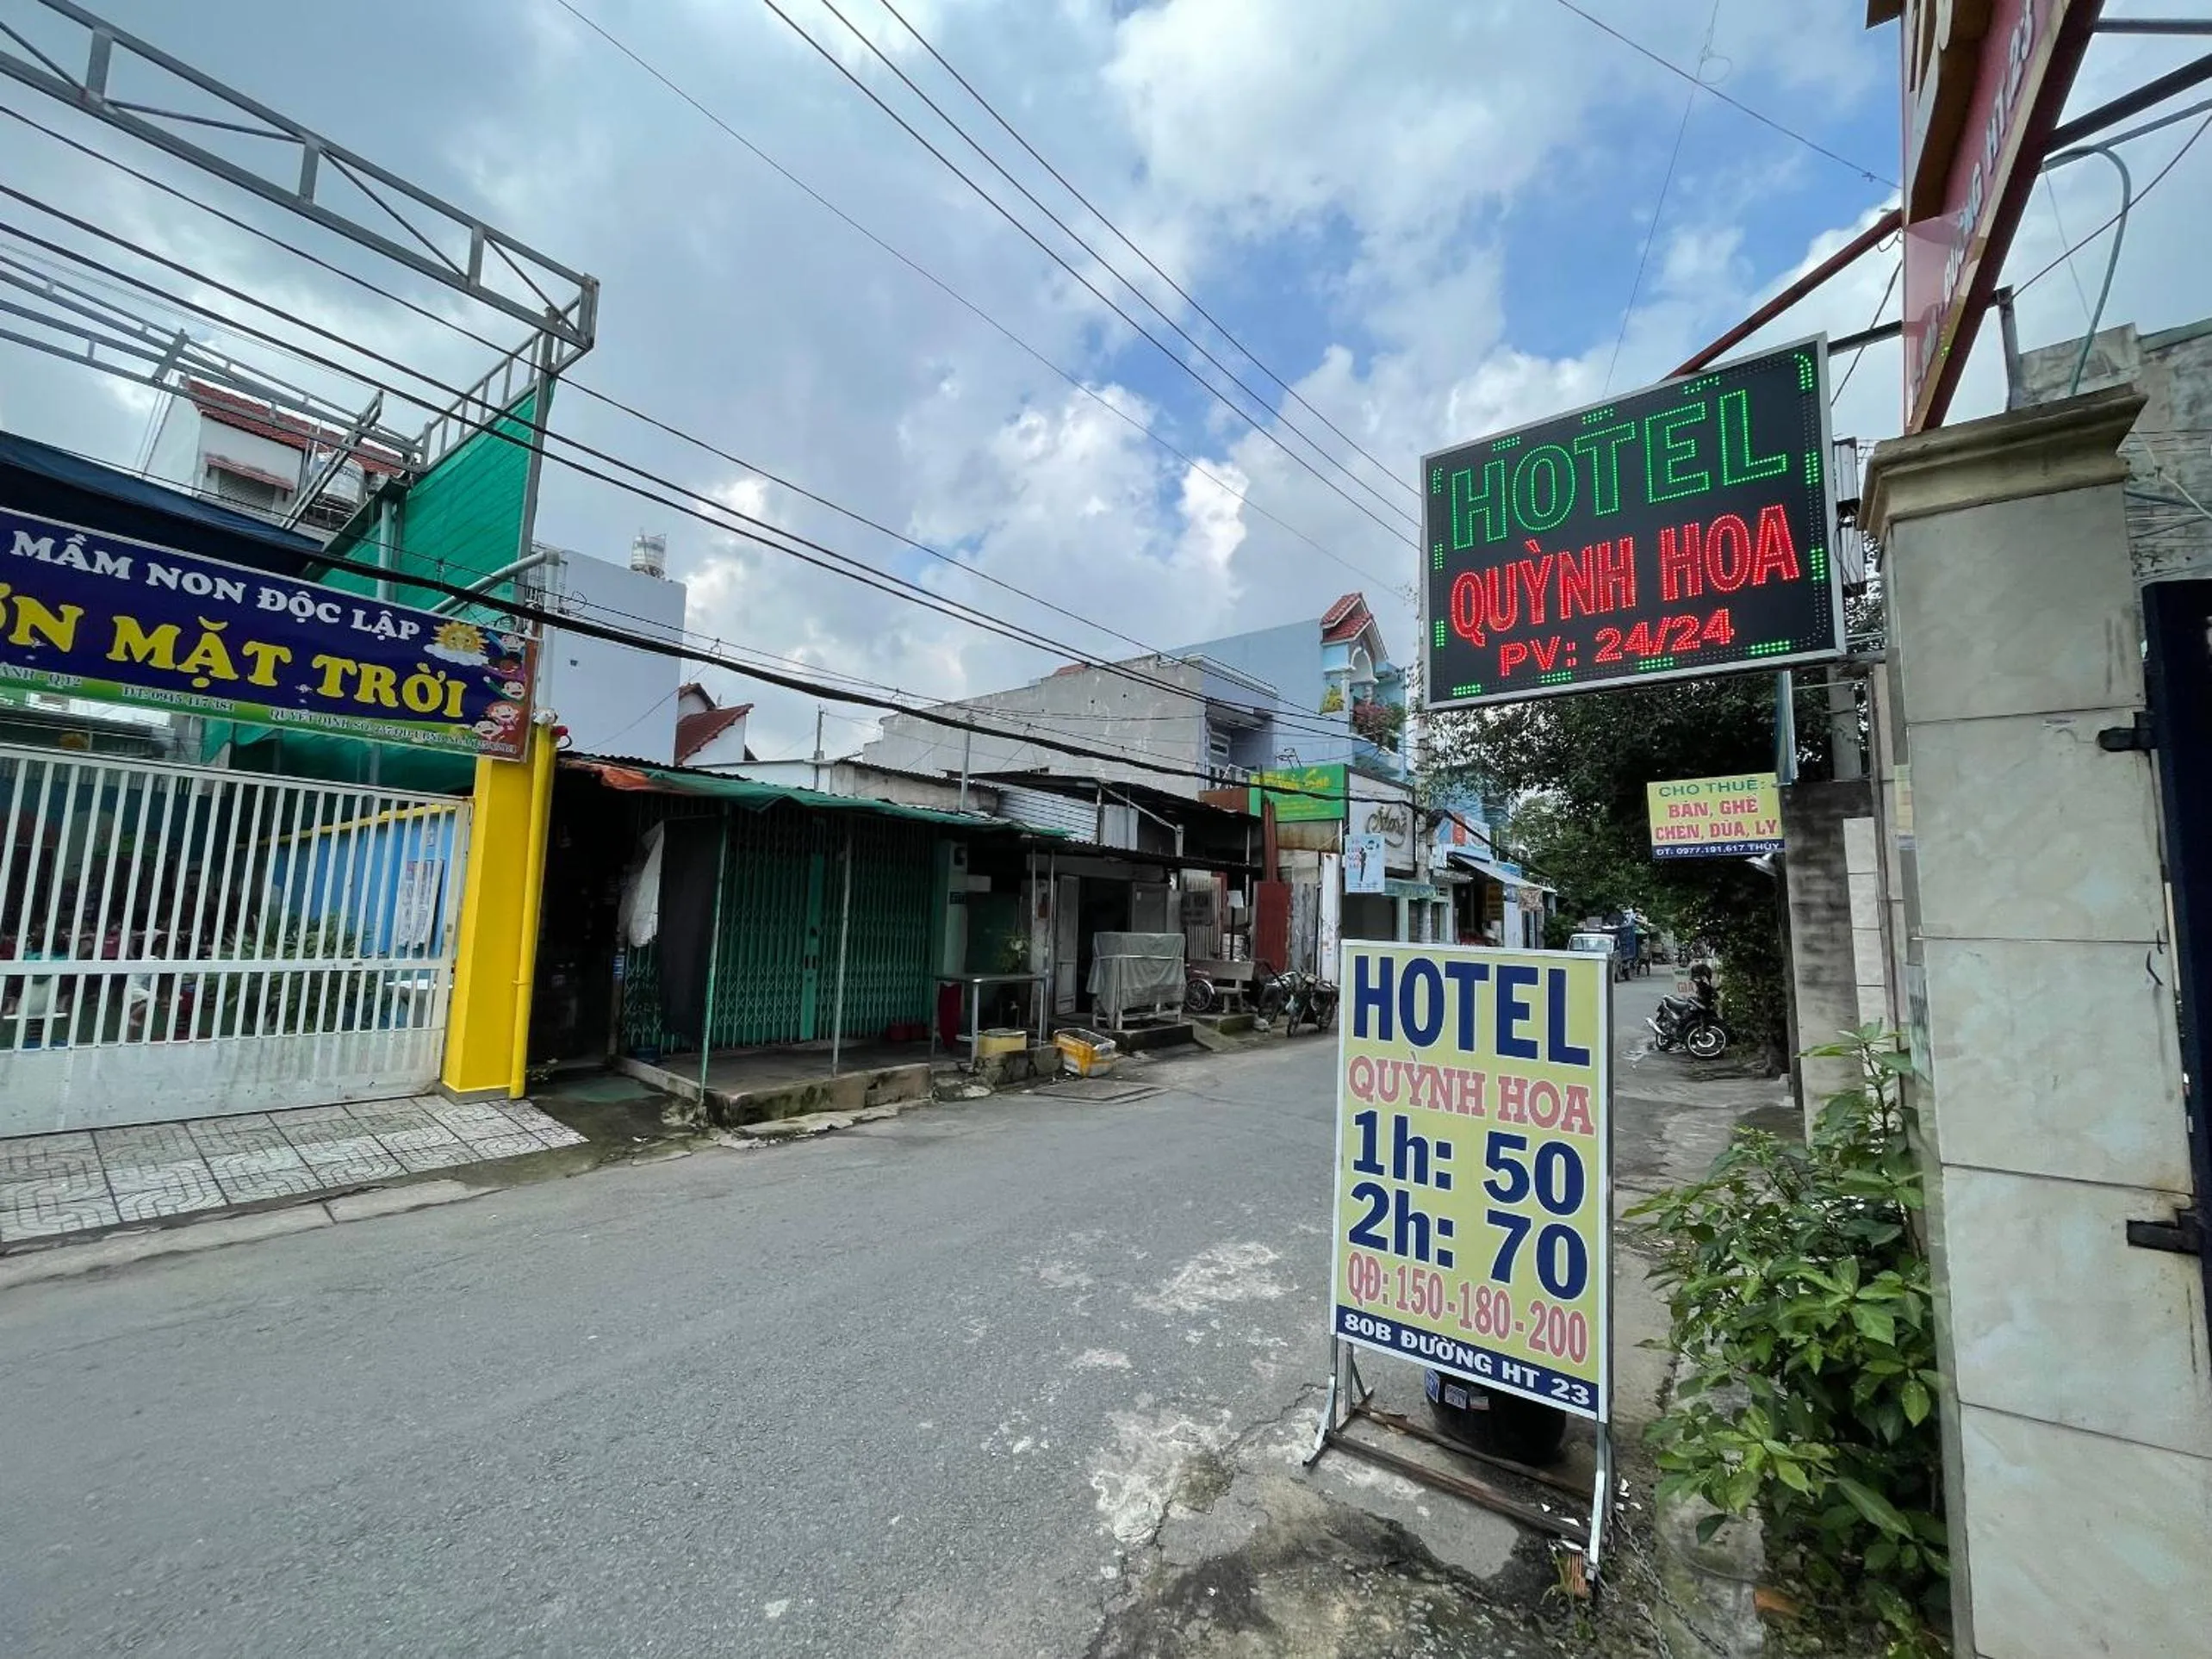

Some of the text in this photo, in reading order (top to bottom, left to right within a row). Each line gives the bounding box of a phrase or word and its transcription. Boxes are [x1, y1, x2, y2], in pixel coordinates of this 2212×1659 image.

[1451, 388, 1788, 550] HOTEL
[9, 531, 421, 643] MẦM NON ĐỘC LẬP
[1450, 503, 1800, 648] QUỲNH HOA
[105, 614, 292, 688] MẶT
[311, 652, 469, 718] TRỜI
[1499, 607, 1735, 678] PV: 24/24
[1658, 777, 1766, 797] CHO THUÊ:
[1755, 819, 1777, 836] LY
[1352, 954, 1592, 1067] HOTEL
[1348, 1052, 1595, 1135] QUỲNH HOA
[1352, 1109, 1586, 1216] 1h: 50
[1348, 1182, 1588, 1301] 2h: 70
[1344, 1314, 1591, 1406] 80B ĐƯỜNG HT 23
